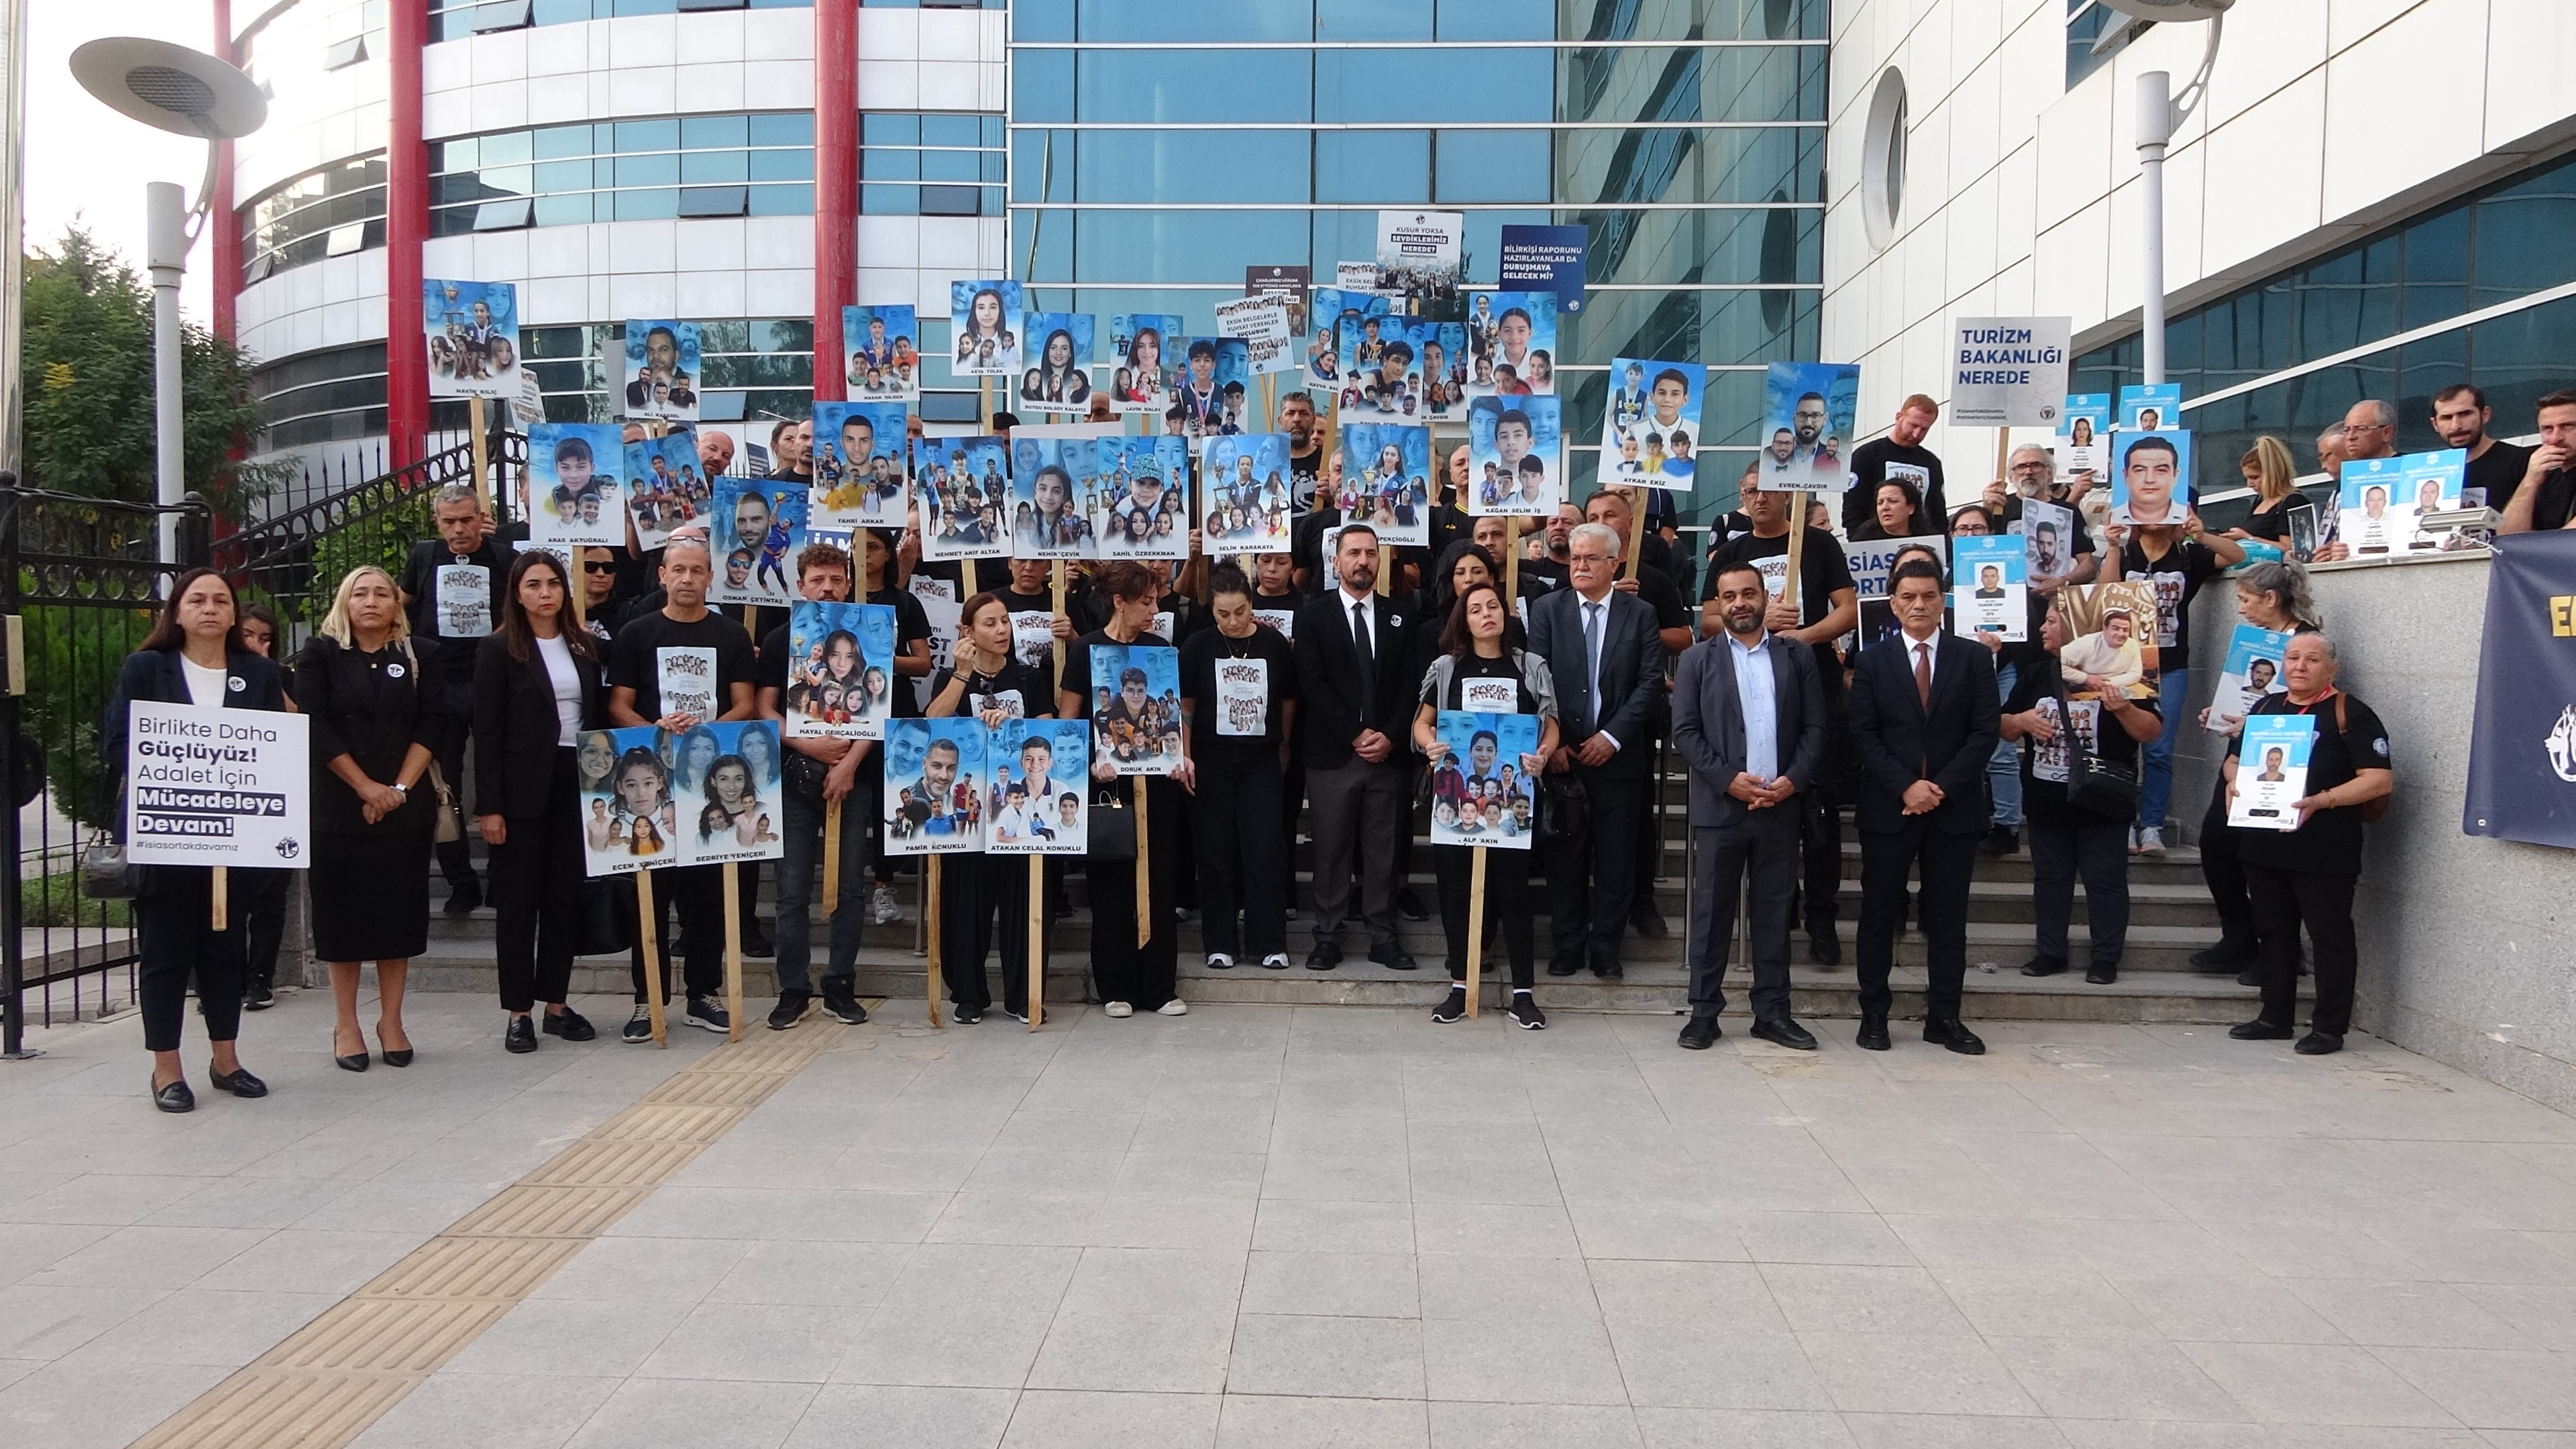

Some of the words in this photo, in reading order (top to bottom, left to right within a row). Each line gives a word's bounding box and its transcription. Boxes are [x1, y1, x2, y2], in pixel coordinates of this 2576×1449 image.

[1392, 235, 1447, 244] SEVDİKLERİMİZ
[1505, 244, 1538, 255] BİLİRKİŞİ
[1538, 246, 1582, 254] RAPORUNU
[1503, 263, 1551, 272] DURUŞMAYA
[1540, 272, 1554, 280] Mİ?
[1962, 326, 2032, 344] TURİZM
[1960, 345, 2062, 364] BAKANLIĞI
[1958, 370, 2031, 384] NEREDE
[1623, 476, 1646, 484] AYKAN
[750, 596, 784, 604] ÇETİNTAŞ
[139, 717, 212, 737] Birlikte
[219, 724, 277, 742] Daha
[138, 740, 257, 765] Güçlüyüz!
[138, 764, 213, 784] Adalet
[219, 765, 257, 790] İçin
[138, 788, 284, 816] Mücadeleye
[137, 815, 233, 835] Devam!
[136, 840, 239, 852] #isiasortakdavamız
[696, 854, 729, 862] BEDRİYE
[732, 850, 766, 859] YENİÇERİ
